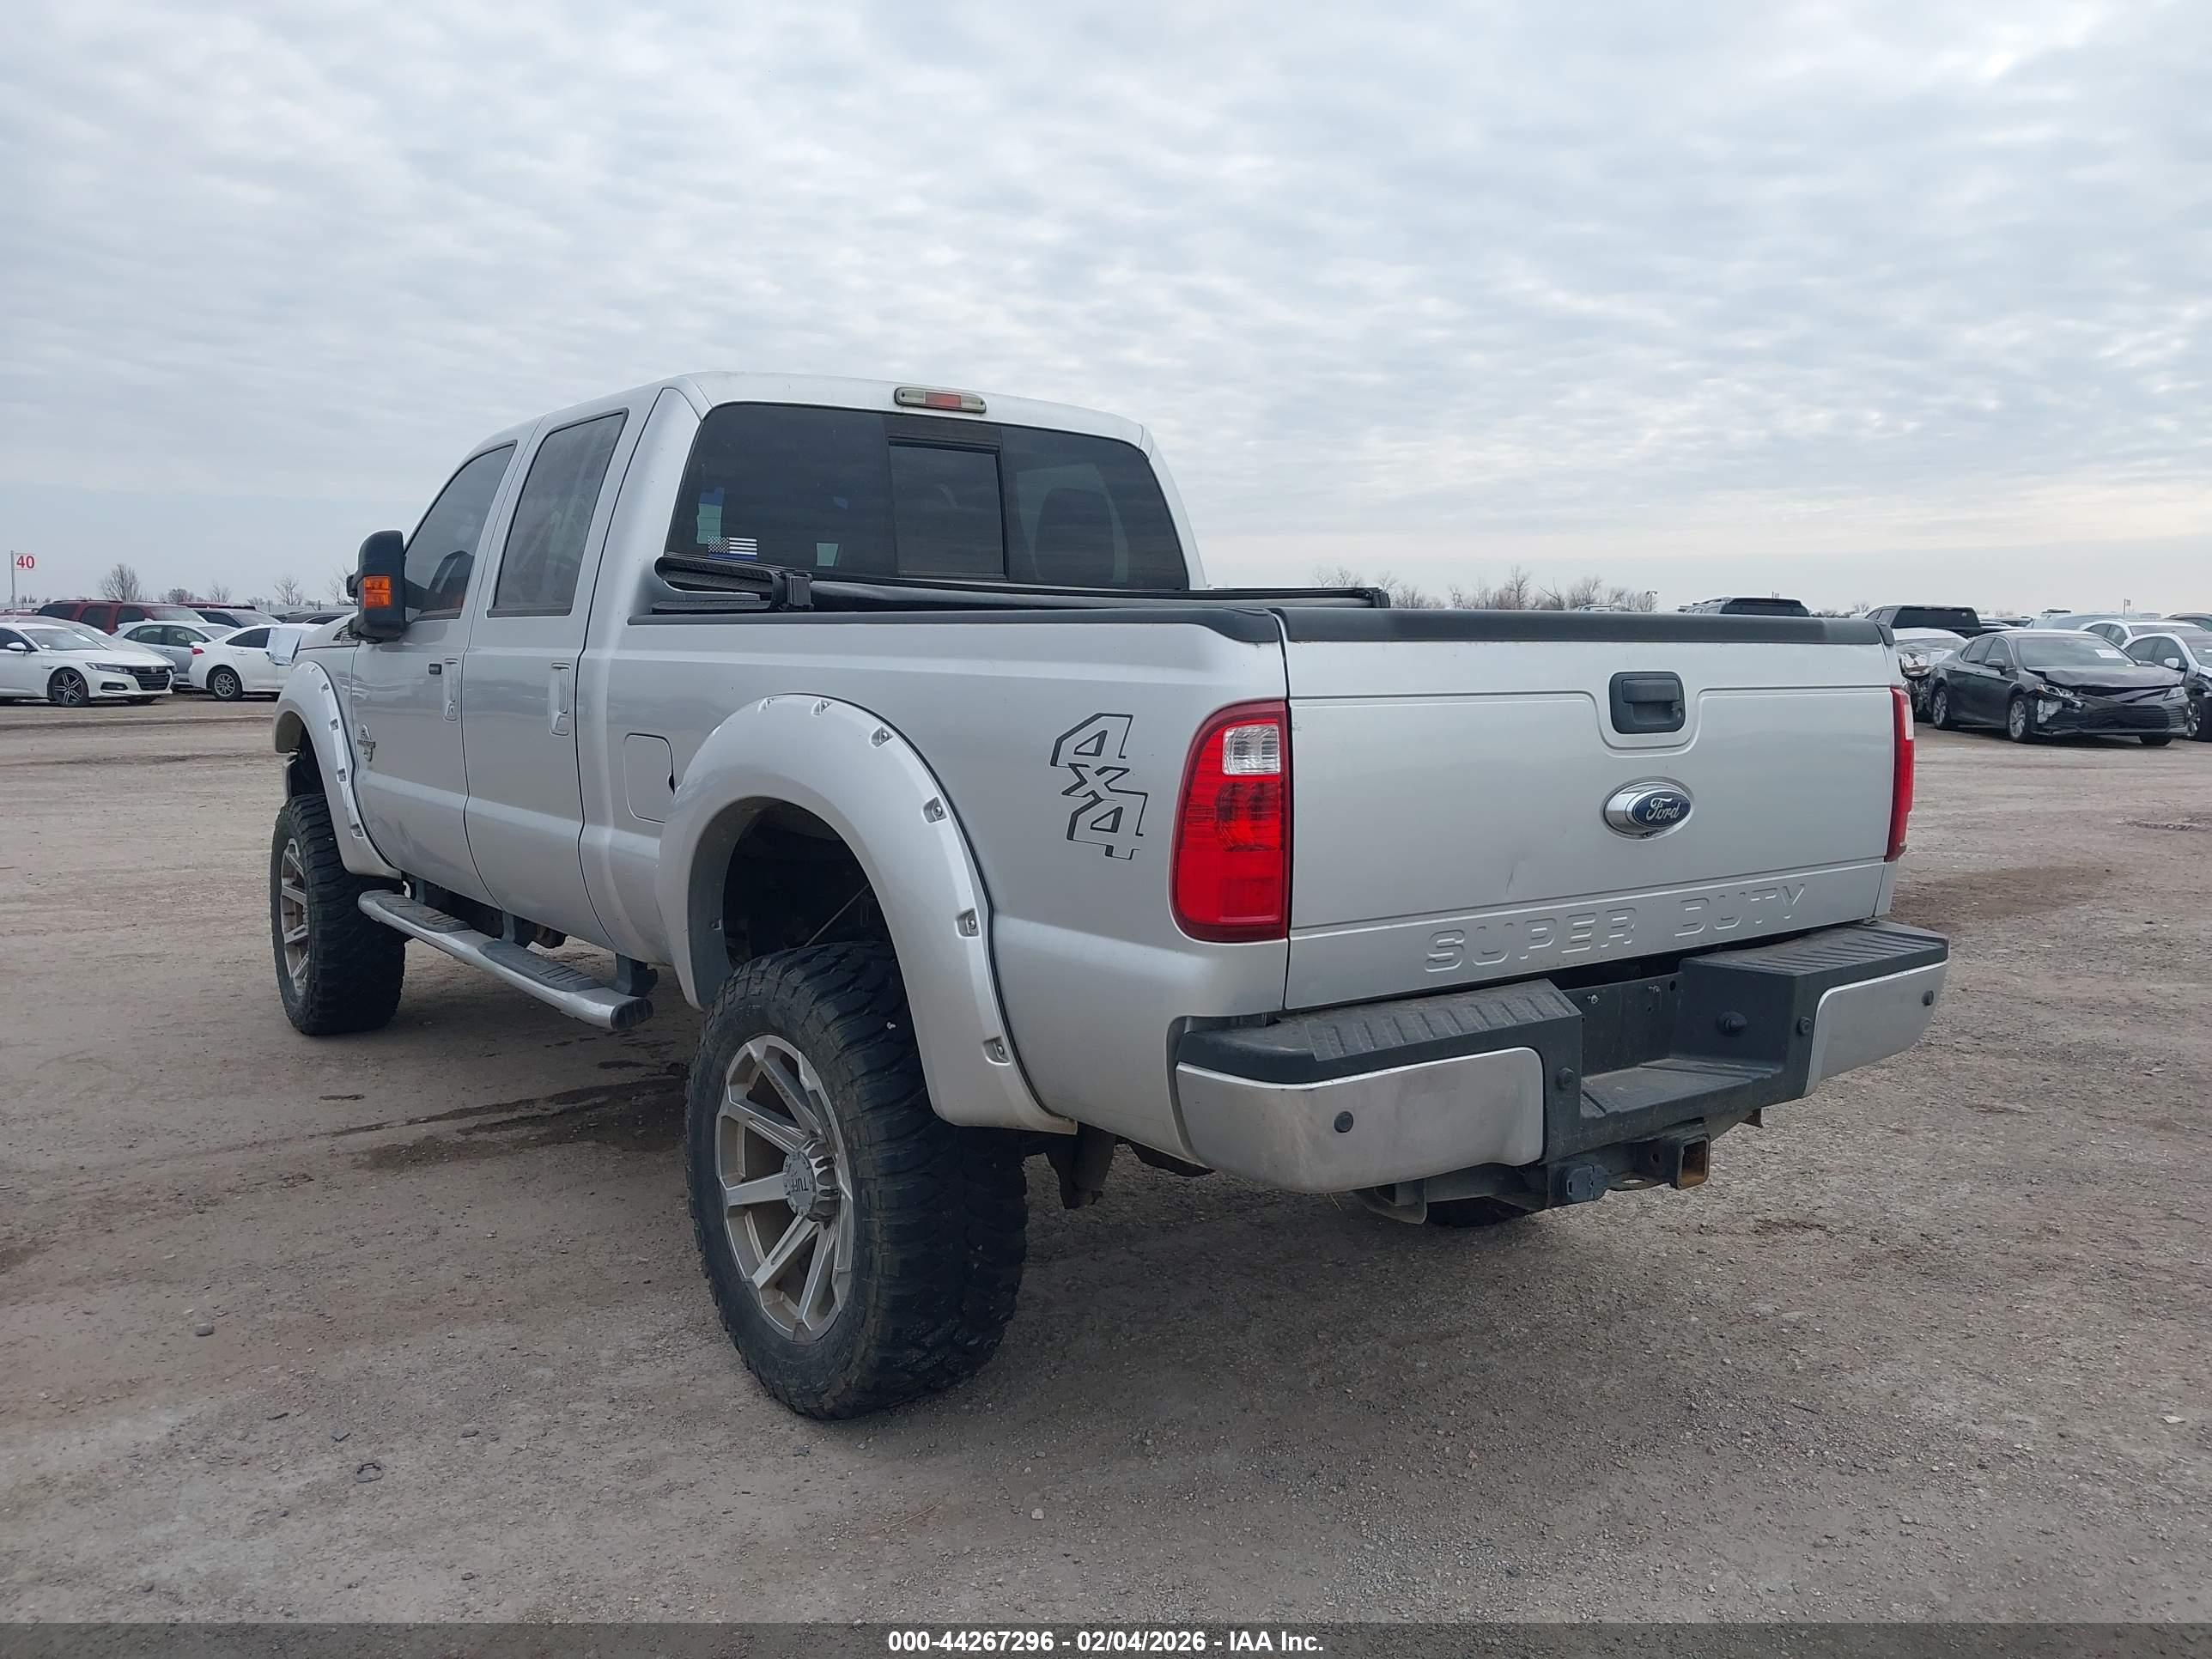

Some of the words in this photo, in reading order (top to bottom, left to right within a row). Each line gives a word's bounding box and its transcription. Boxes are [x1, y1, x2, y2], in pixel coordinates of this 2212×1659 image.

[16, 555, 35, 568] 40
[1645, 797, 1681, 821] Ford
[1424, 907, 1638, 973] SUPER
[1674, 883, 1806, 938] DUTY
